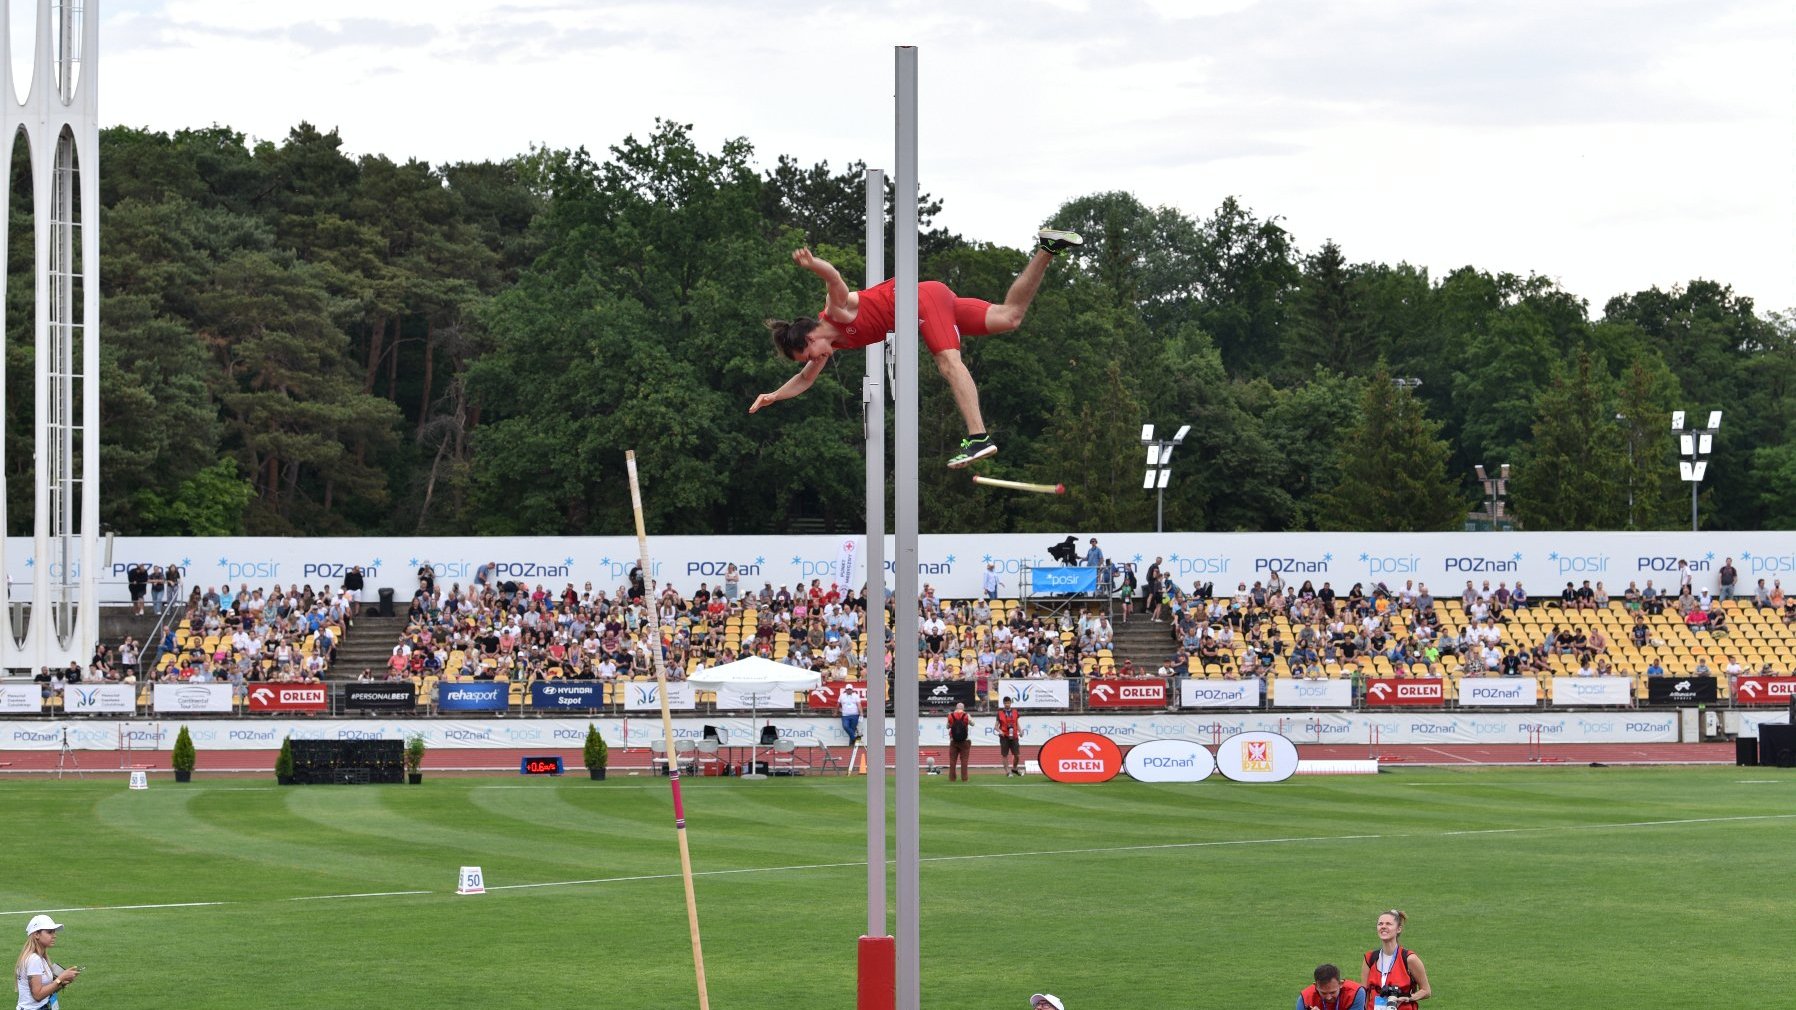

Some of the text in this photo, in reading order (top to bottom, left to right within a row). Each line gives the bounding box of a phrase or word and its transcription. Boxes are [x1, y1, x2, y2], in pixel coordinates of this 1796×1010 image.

[611, 558, 662, 581] poir
[687, 562, 760, 577] POZan
[1180, 555, 1231, 577] posir
[1255, 558, 1328, 573] POZnan
[1369, 553, 1421, 577] posir
[1445, 557, 1517, 573] POZnan
[1559, 552, 1611, 576] posir
[1638, 556, 1710, 572] POZan
[229, 559, 280, 582] posir
[496, 562, 569, 578] POZnan
[1052, 575, 1080, 587] posir
[1122, 688, 1160, 697] ORLEN
[1195, 689, 1242, 700] POZnan
[1299, 684, 1328, 697] posir
[1400, 686, 1438, 696] ORLEN
[1472, 688, 1520, 698] POZnan
[1577, 683, 1607, 695] posir
[282, 691, 321, 701] ORLEN
[351, 692, 410, 701] #PERSONALBEST
[447, 689, 498, 703] rehasport
[557, 696, 582, 705] Szpot
[1090, 725, 1135, 736] POZnan
[1197, 724, 1242, 735] POZnan
[1305, 724, 1350, 734] POZnan
[1411, 723, 1456, 734] POZnan
[1518, 723, 1563, 733] POZnan
[1626, 722, 1670, 733] POZnan
[14, 731, 58, 741] POZnan
[229, 730, 274, 741] POZnan
[445, 730, 490, 740] POZnan
[1062, 761, 1101, 770] ORLEN
[1144, 757, 1194, 768] POZnan
[467, 874, 480, 887] 50
